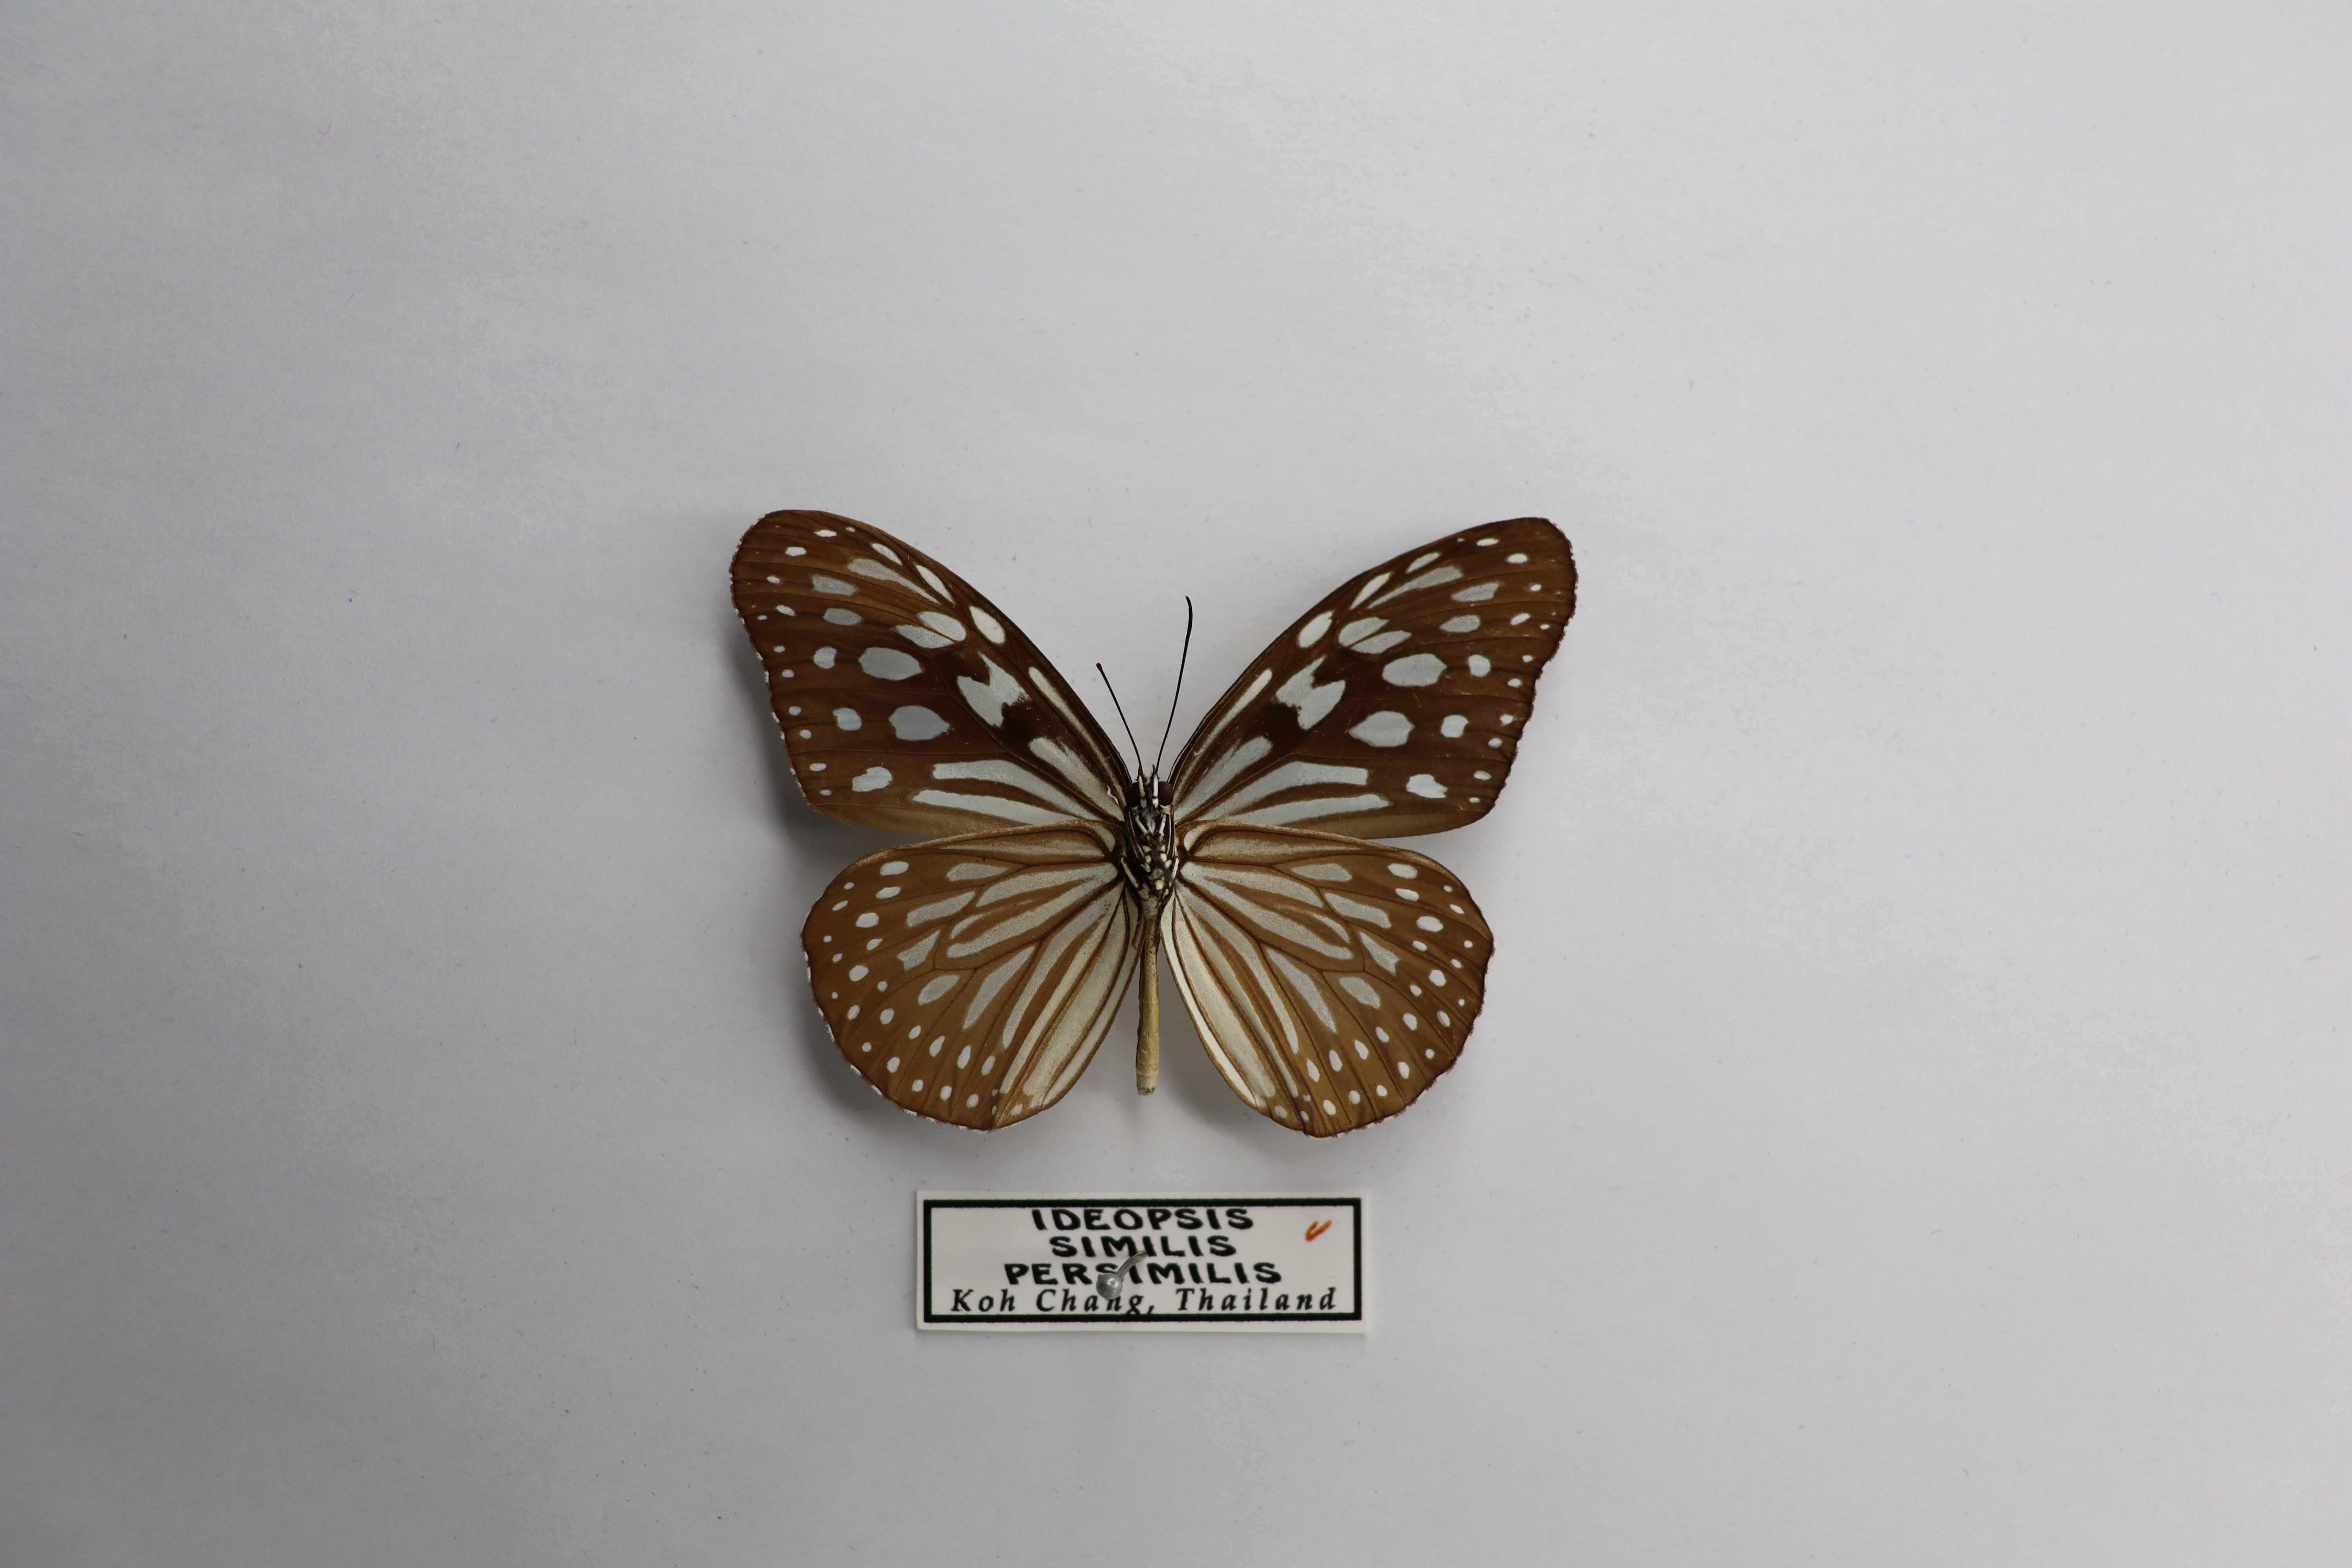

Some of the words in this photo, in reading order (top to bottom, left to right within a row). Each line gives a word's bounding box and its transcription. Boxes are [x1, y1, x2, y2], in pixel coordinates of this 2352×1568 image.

[1031, 1208, 1254, 1231] IDEOPSIS
[1049, 1235, 1236, 1258] SIMILIS
[951, 1289, 1015, 1312] Koh
[1036, 1288, 1155, 1315] Chang,
[1176, 1287, 1336, 1311] Thailand
